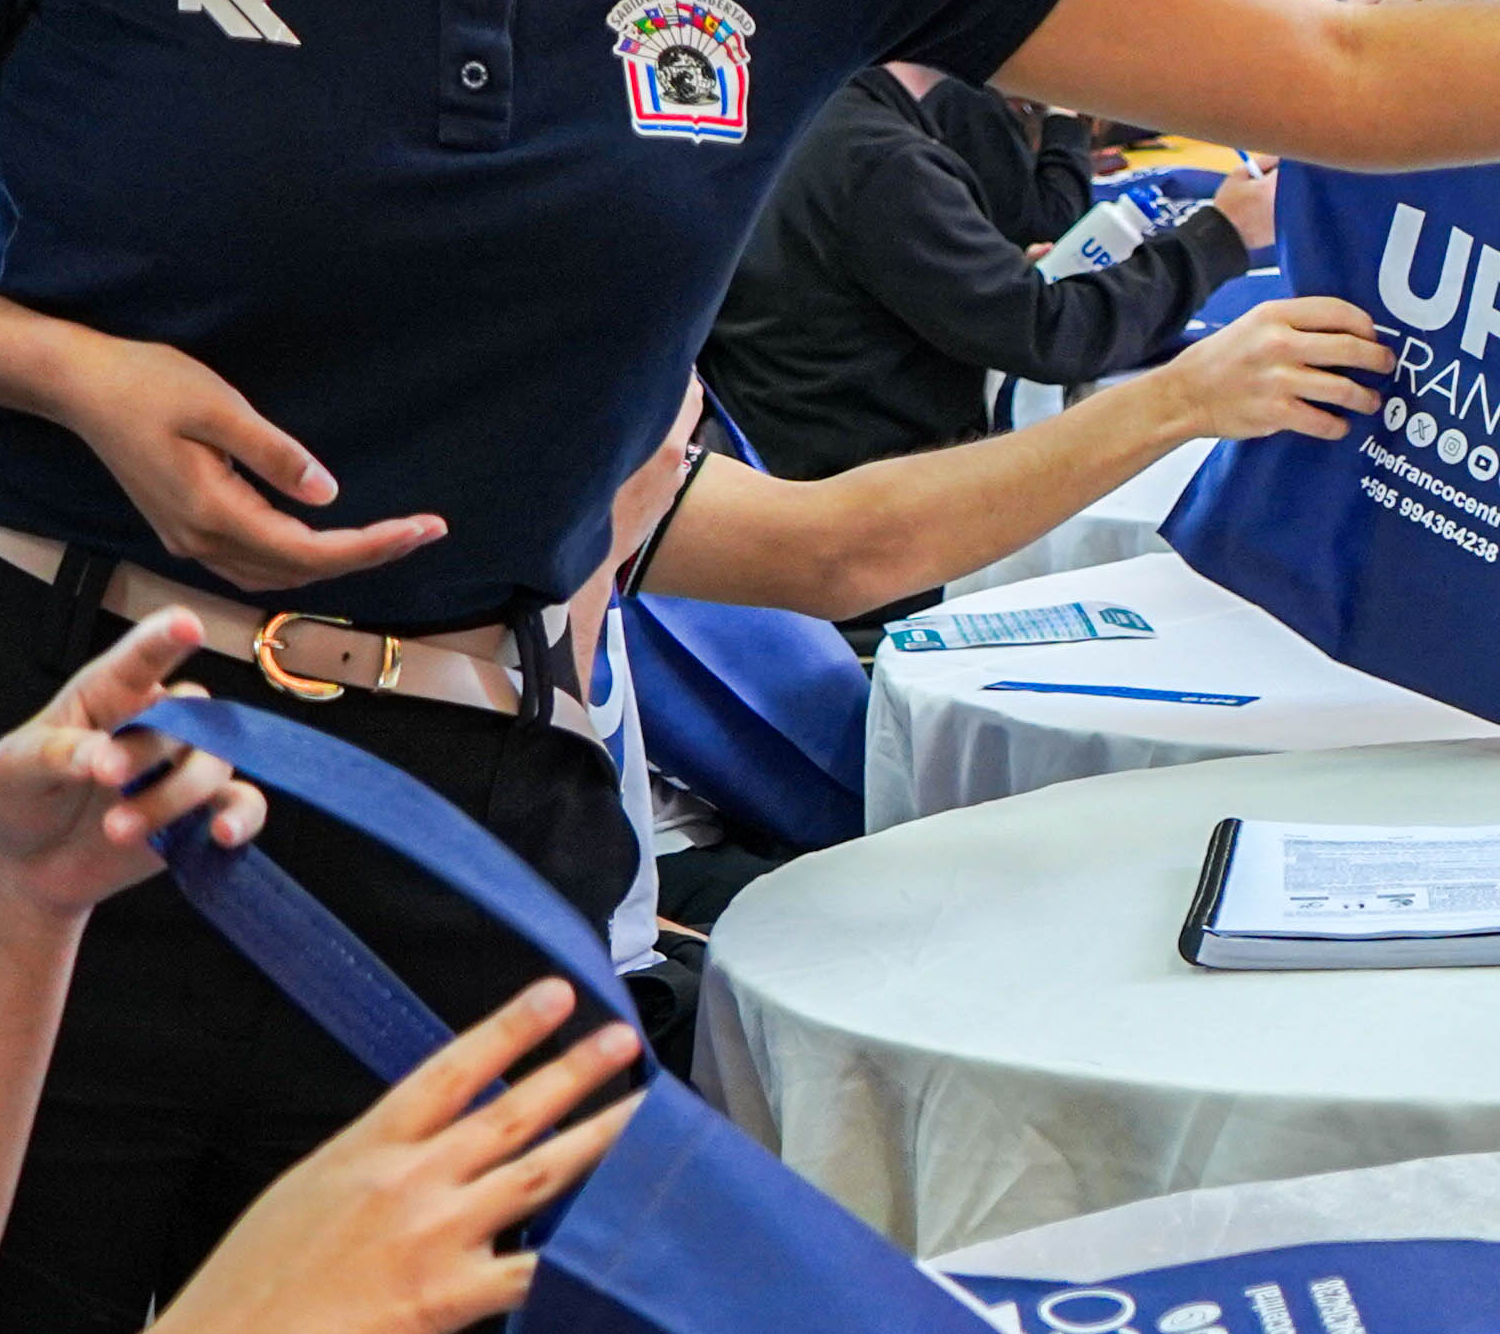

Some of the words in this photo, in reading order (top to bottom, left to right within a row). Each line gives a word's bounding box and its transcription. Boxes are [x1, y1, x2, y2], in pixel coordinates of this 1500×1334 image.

[1082, 237, 1117, 267] UP
[1360, 475, 1399, 509] +595
[1400, 497, 1499, 563] 994364238
